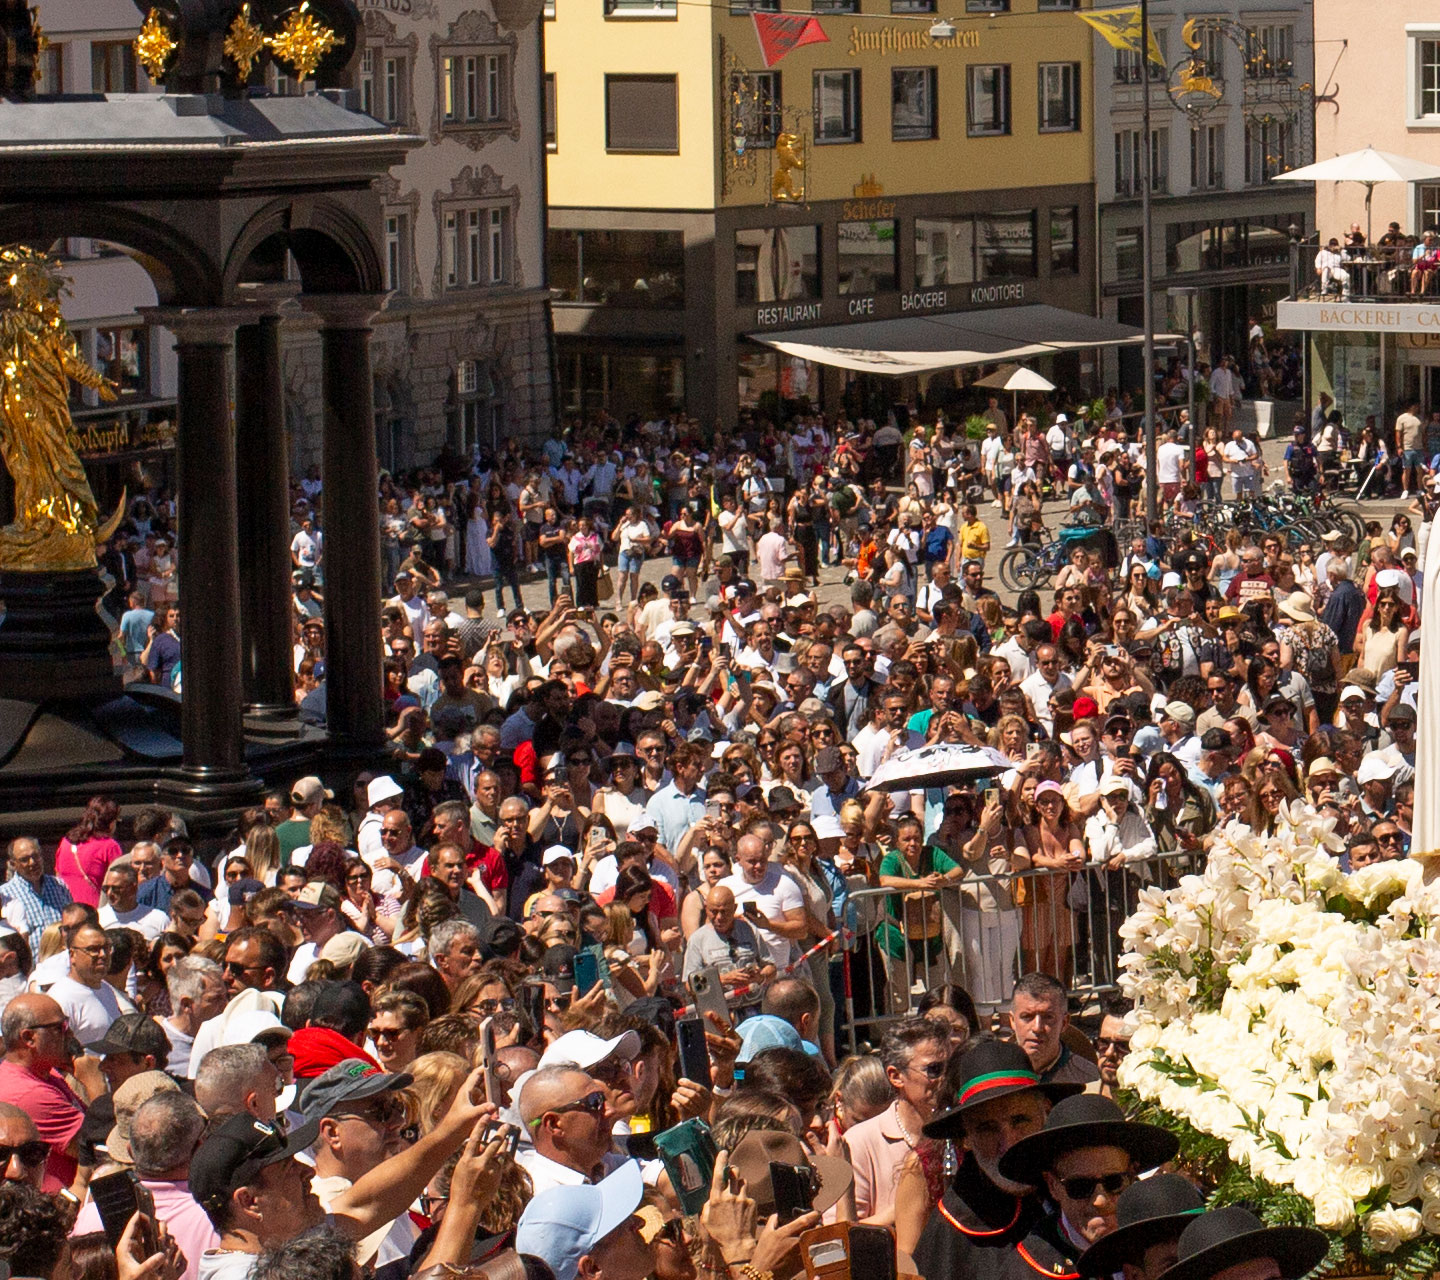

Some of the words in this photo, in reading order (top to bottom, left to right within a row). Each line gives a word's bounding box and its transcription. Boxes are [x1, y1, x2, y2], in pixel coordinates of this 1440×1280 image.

[757, 303, 822, 325] RESTAURANT
[849, 298, 875, 316] CAFE
[971, 283, 1026, 304] KONDITOREI
[1320, 308, 1401, 326] BÄCKEREI
